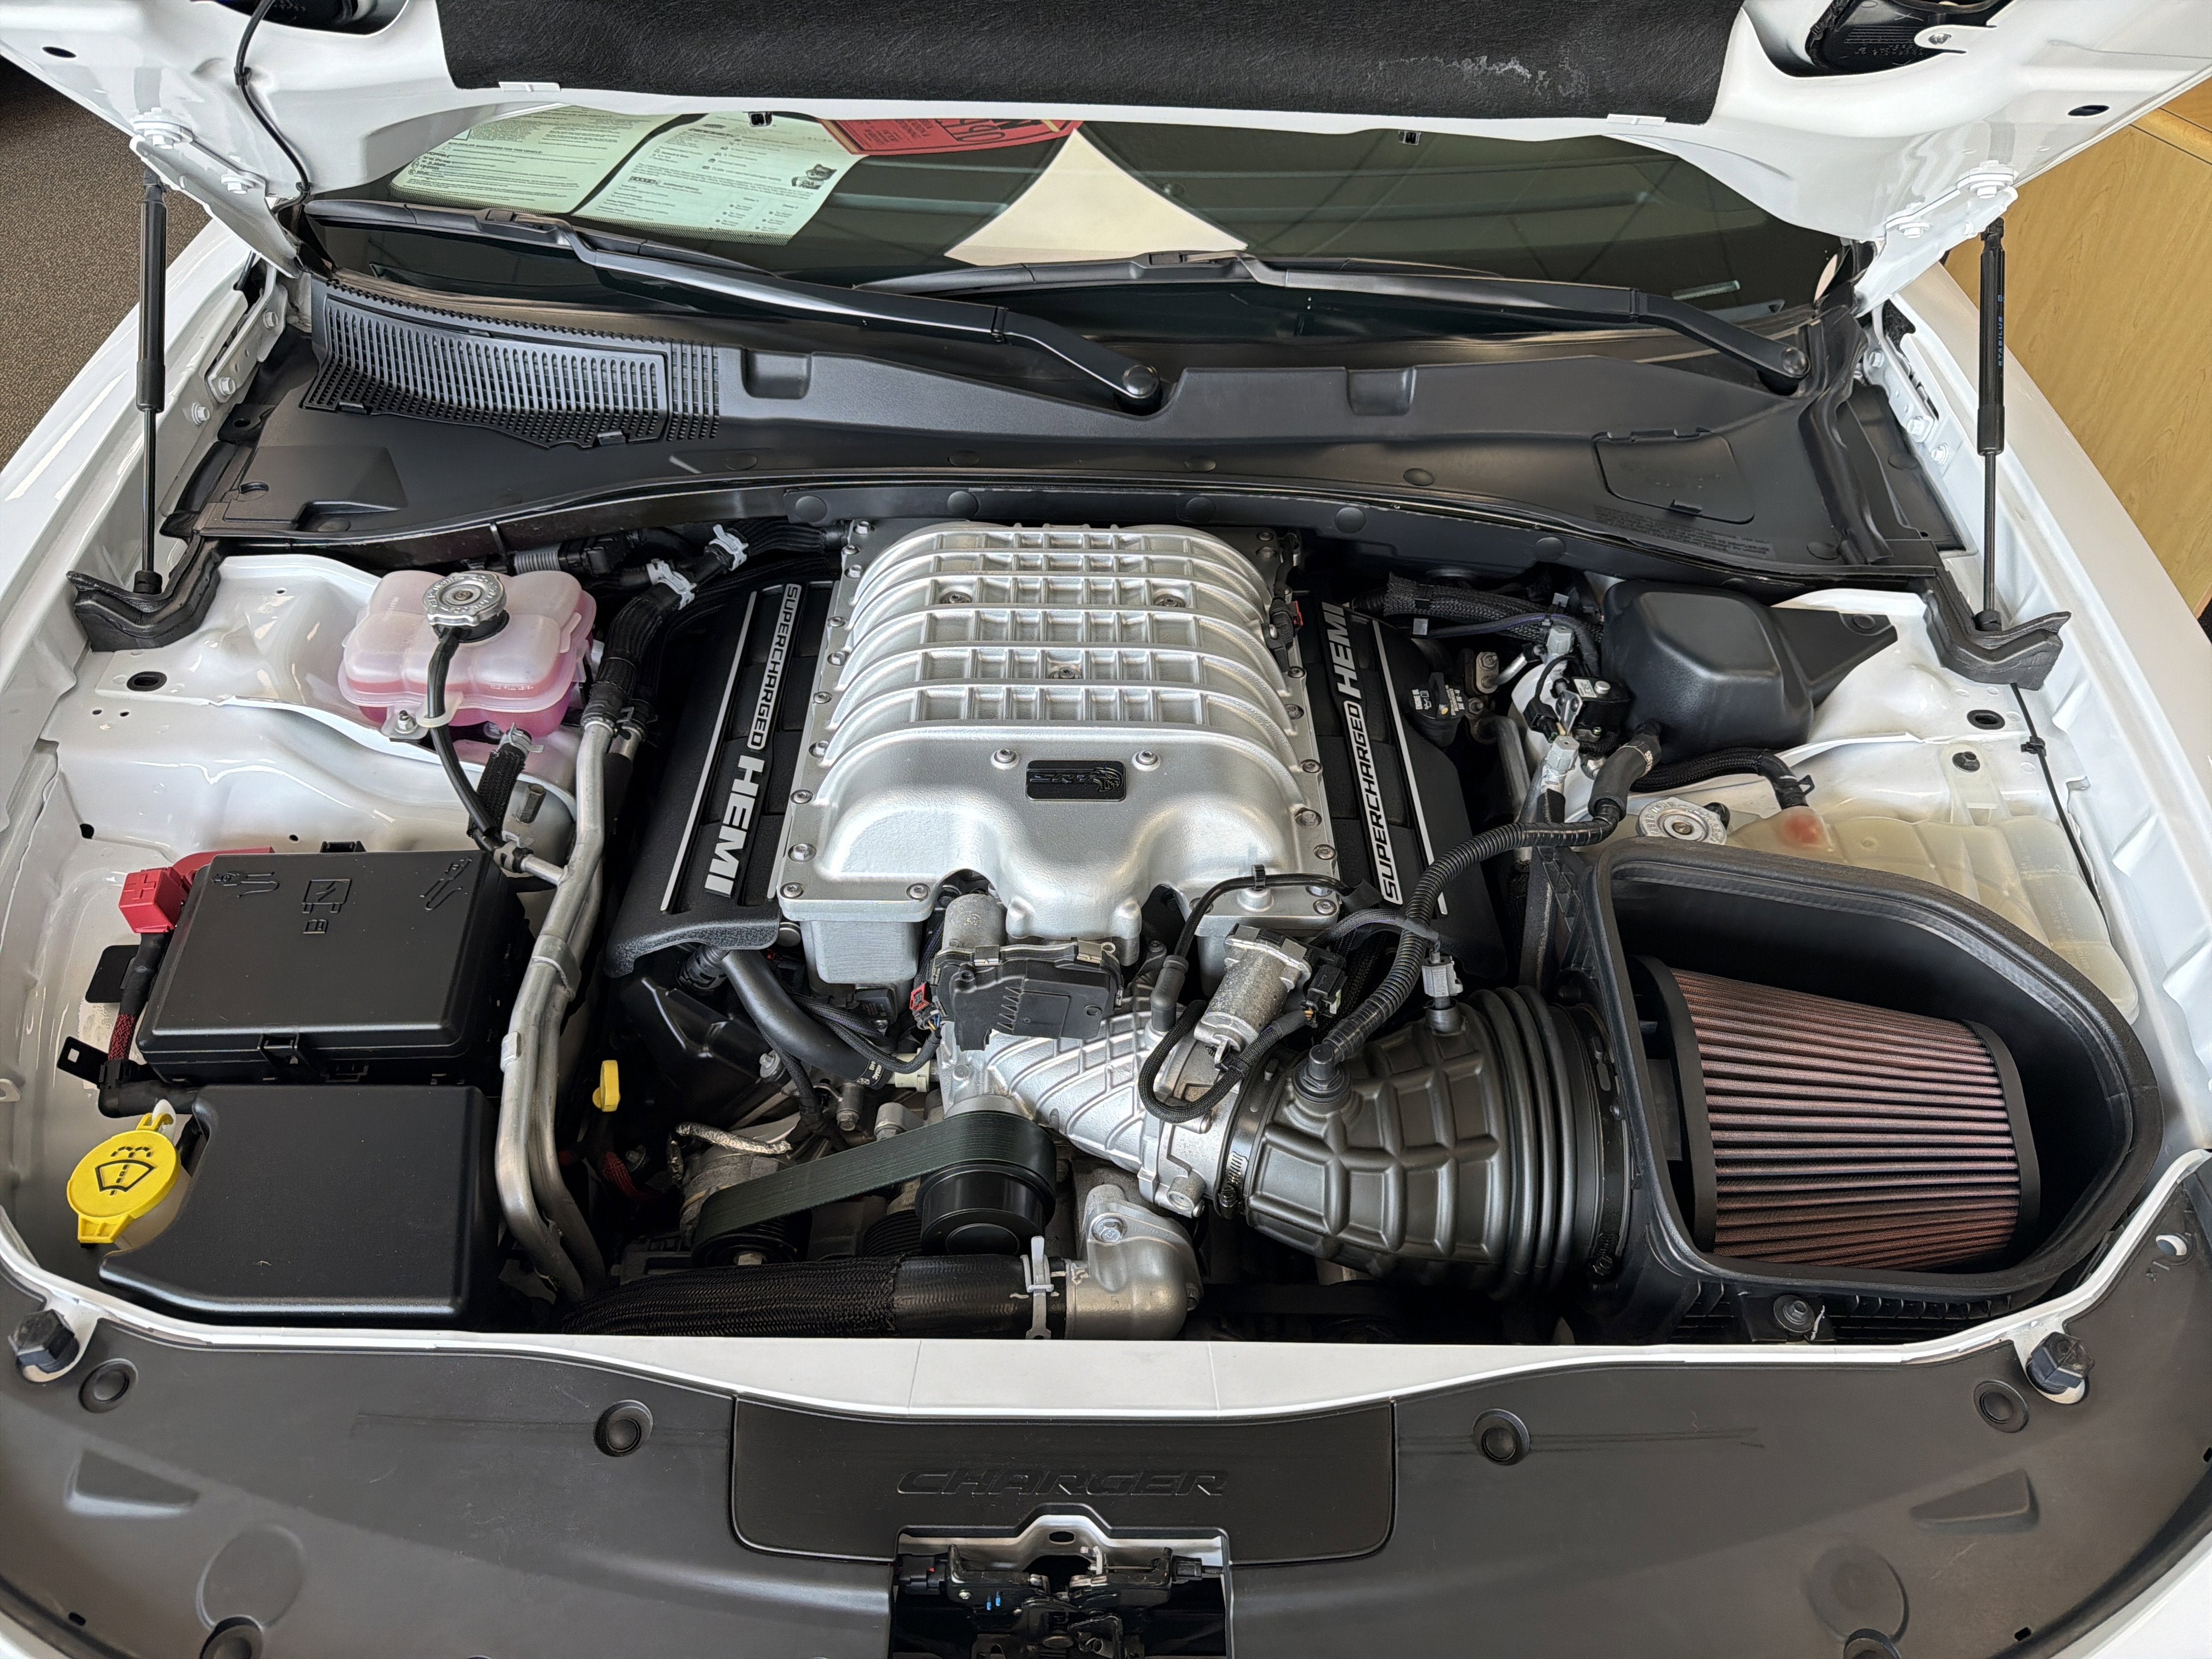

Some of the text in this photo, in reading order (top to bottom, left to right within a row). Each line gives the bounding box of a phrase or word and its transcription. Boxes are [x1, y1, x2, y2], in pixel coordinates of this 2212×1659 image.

[704, 585, 800, 896] SUPERCHARGED HEMI
[1322, 601, 1400, 903] SUPERCHARGED HEMI
[898, 1469, 1227, 1496] CHARGER
